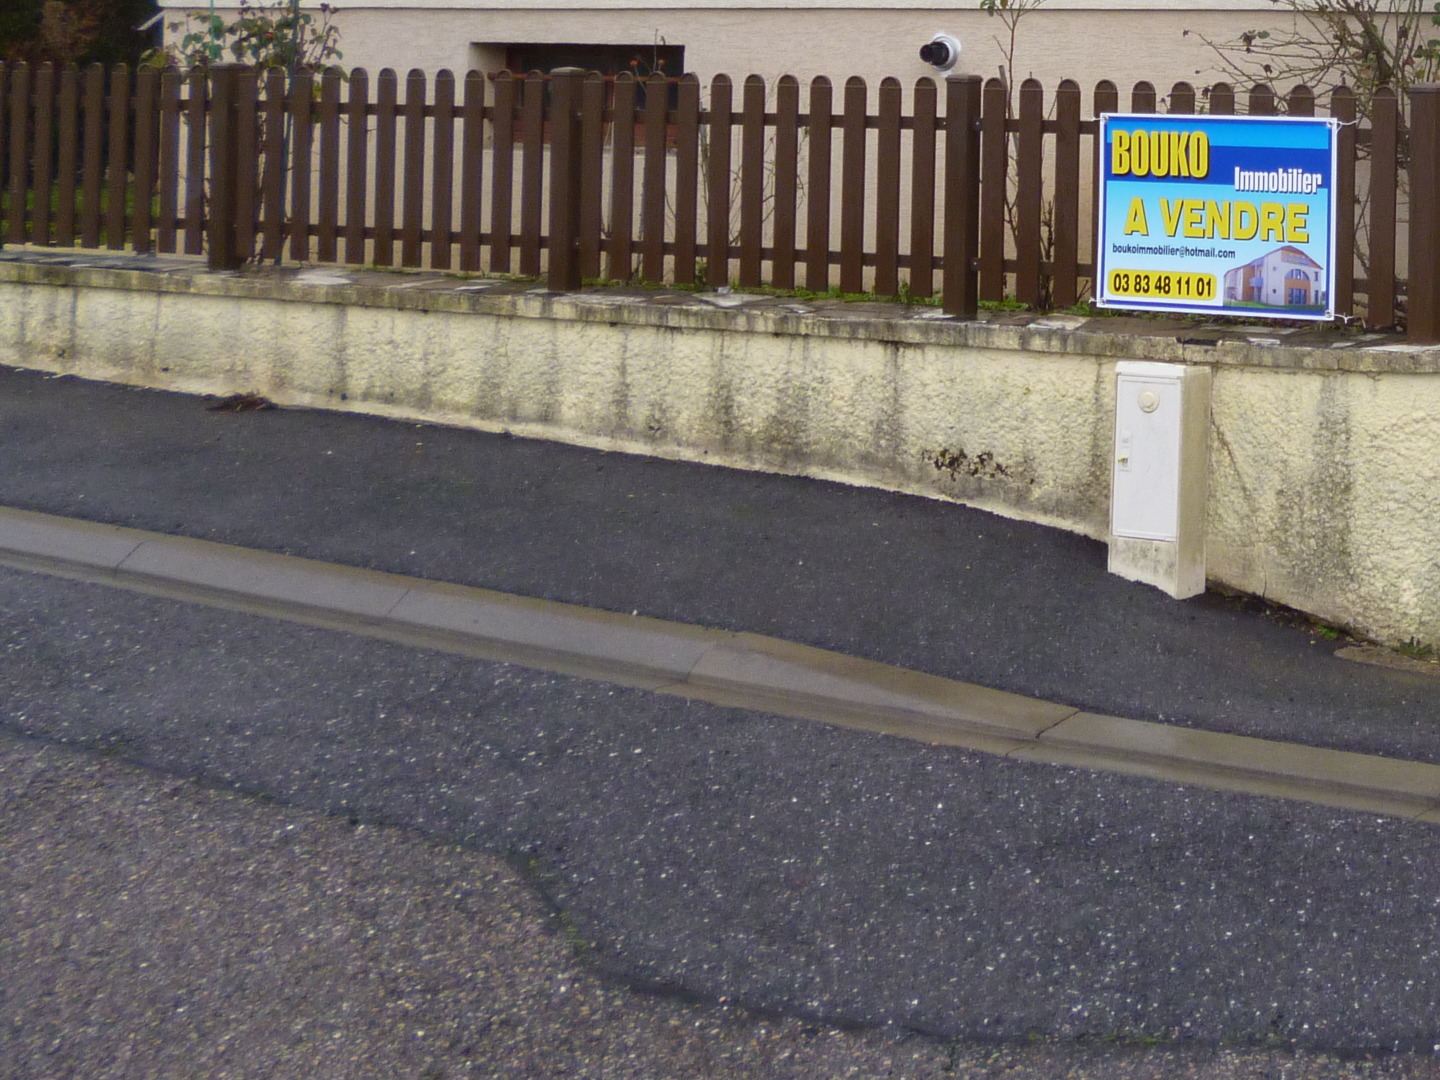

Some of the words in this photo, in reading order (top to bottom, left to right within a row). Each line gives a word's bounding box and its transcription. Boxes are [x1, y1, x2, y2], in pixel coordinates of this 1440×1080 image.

[1111, 130, 1209, 178] BOUKO
[1234, 166, 1322, 193] Immobilier
[1124, 197, 1149, 236] A
[1159, 198, 1309, 243] VENDRE
[1112, 243, 1236, 259] boukoimmobilier@hotmail.com
[1113, 273, 1130, 292] 03
[1134, 274, 1150, 294] 83
[1154, 275, 1171, 295] 48
[1176, 276, 1191, 296] 11
[1196, 277, 1212, 297] 01
